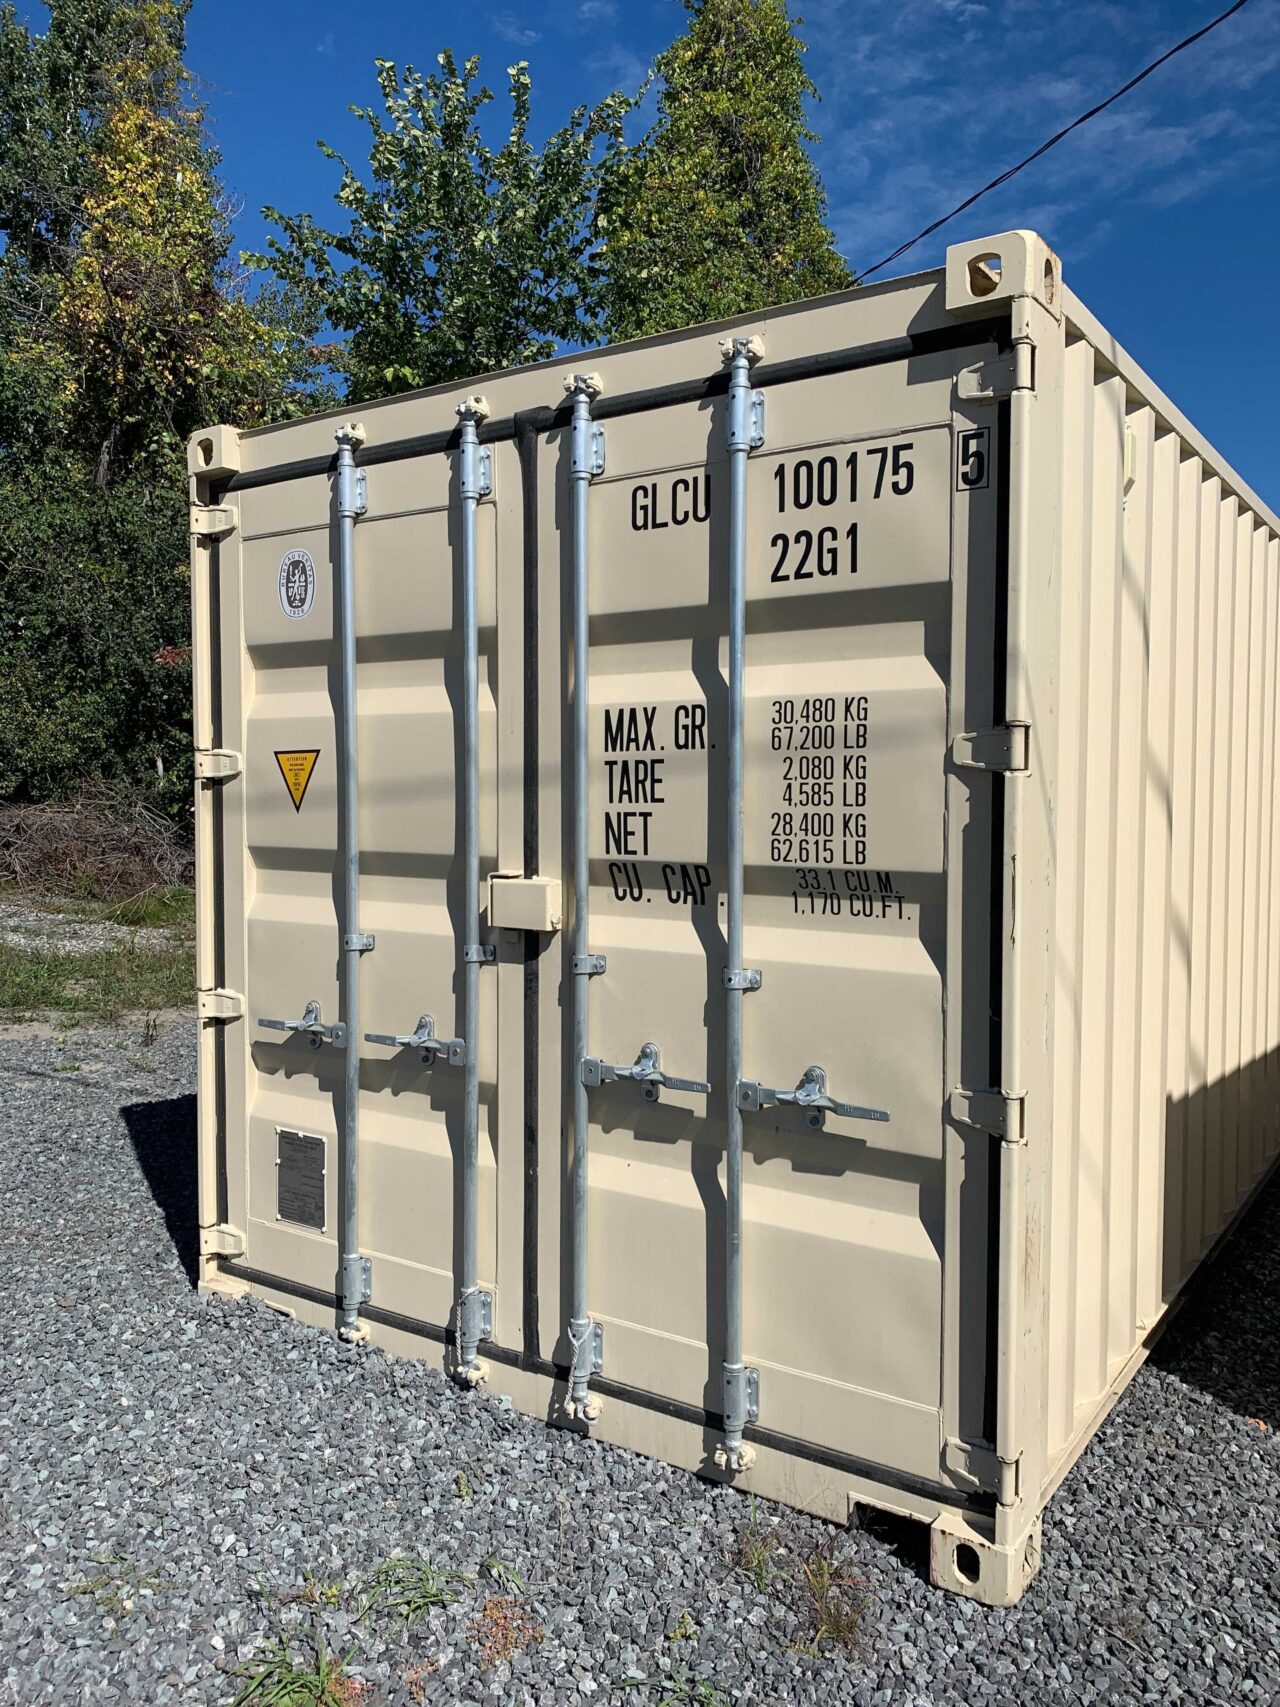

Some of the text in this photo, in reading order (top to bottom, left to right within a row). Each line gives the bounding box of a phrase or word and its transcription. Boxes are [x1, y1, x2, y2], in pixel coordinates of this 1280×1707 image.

[631, 431, 985, 531] GLCU 100175 5
[770, 522, 858, 583] 22G1
[772, 696, 869, 725] 30,480 KG
[604, 704, 716, 753] MAX. GR.
[771, 724, 868, 752] 67,200 LB
[604, 759, 665, 804] TARE
[783, 755, 867, 781] 2,080 KG
[782, 782, 867, 808] 4,585 LB
[605, 812, 653, 856] NET
[770, 812, 867, 839] 28,400 KG
[770, 838, 867, 865] 62,615 LB
[608, 862, 725, 907] CU. CAP.
[795, 868, 900, 894] 33.1 CU.M.
[791, 891, 912, 921] 1,170 CU.FT.
